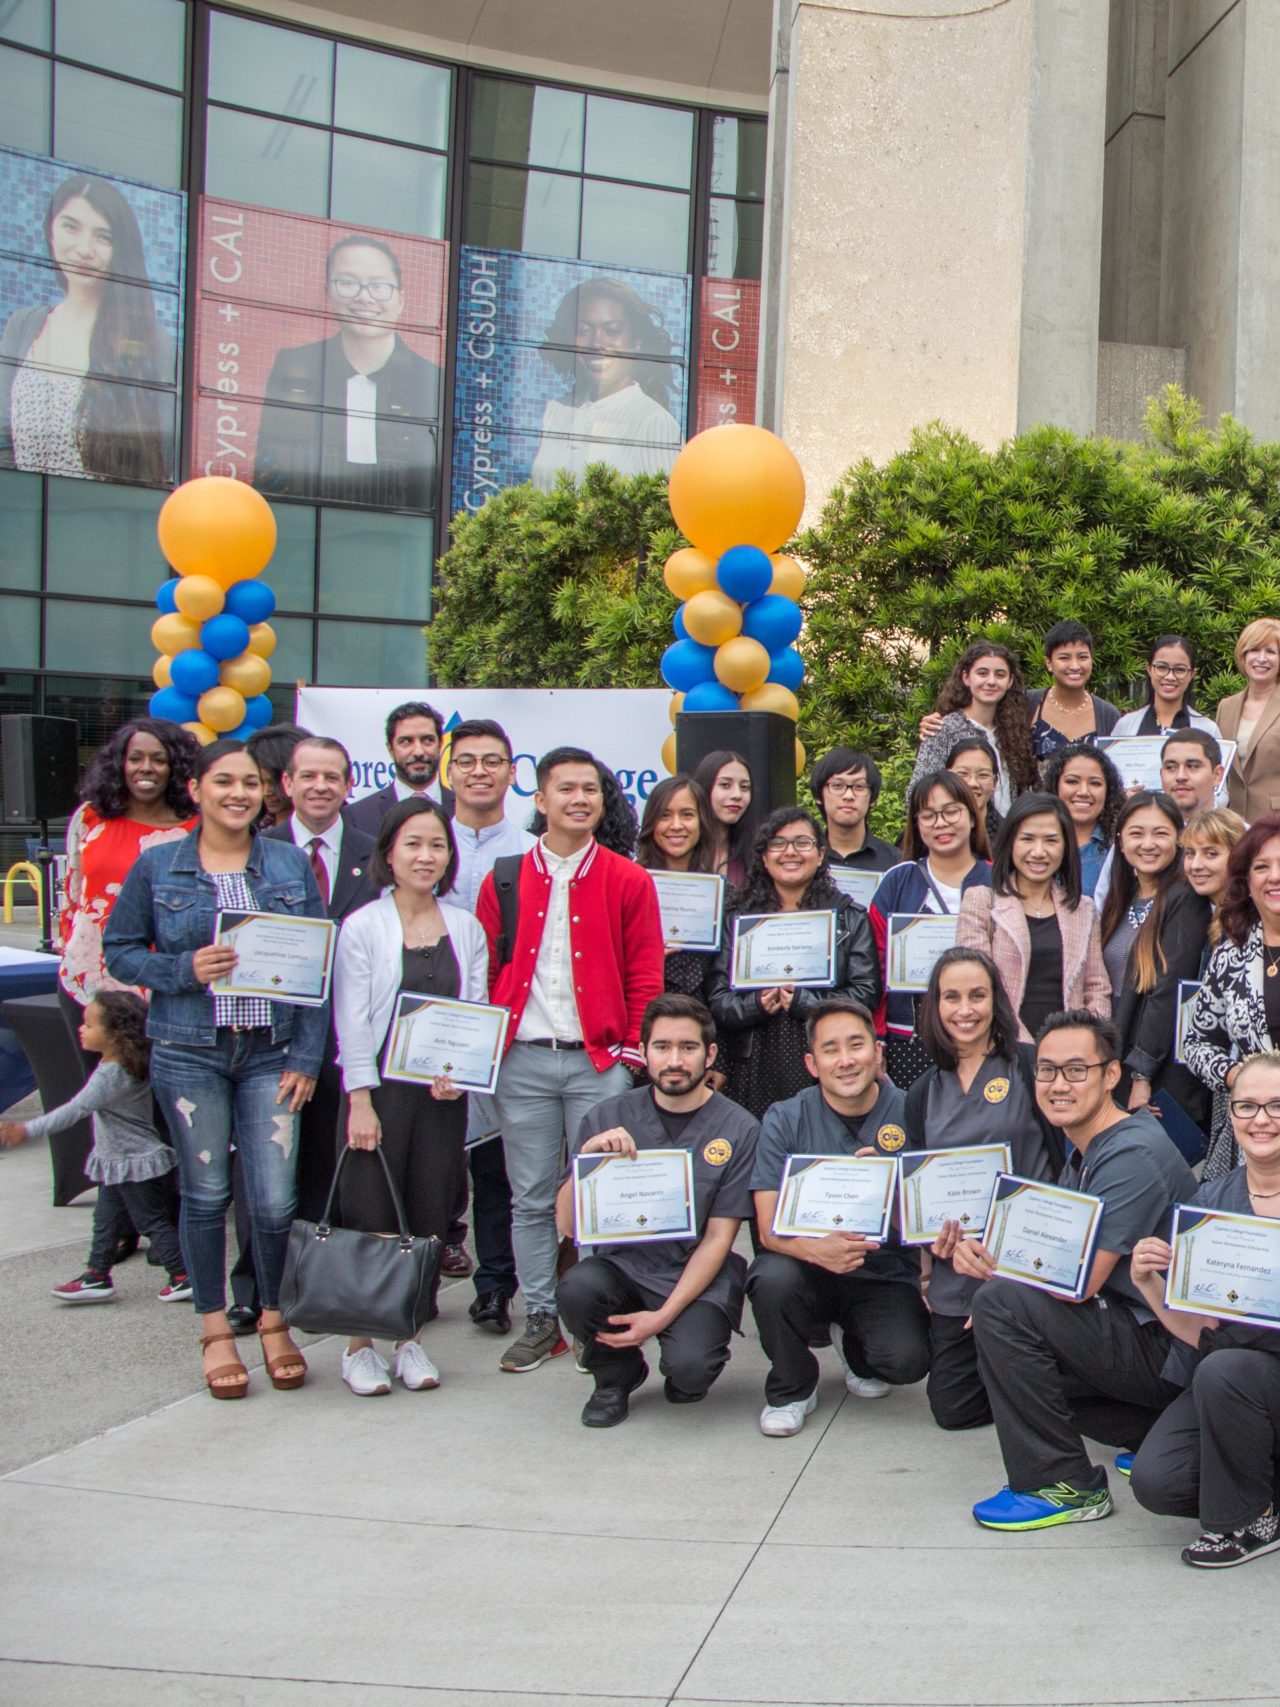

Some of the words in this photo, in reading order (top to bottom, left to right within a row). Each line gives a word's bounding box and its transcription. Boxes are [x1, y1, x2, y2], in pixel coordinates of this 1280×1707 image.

[209, 213, 244, 284] CAL
[468, 255, 498, 360] CSUDH
[711, 288, 741, 351] CAL
[205, 342, 247, 479] Cypress
[463, 402, 499, 511] Cypress
[620, 1191, 638, 1199] Angel
[961, 1188, 982, 1196] Brown
[1206, 1258, 1235, 1269] Kateryna
[1236, 1262, 1272, 1275] Fernandez
